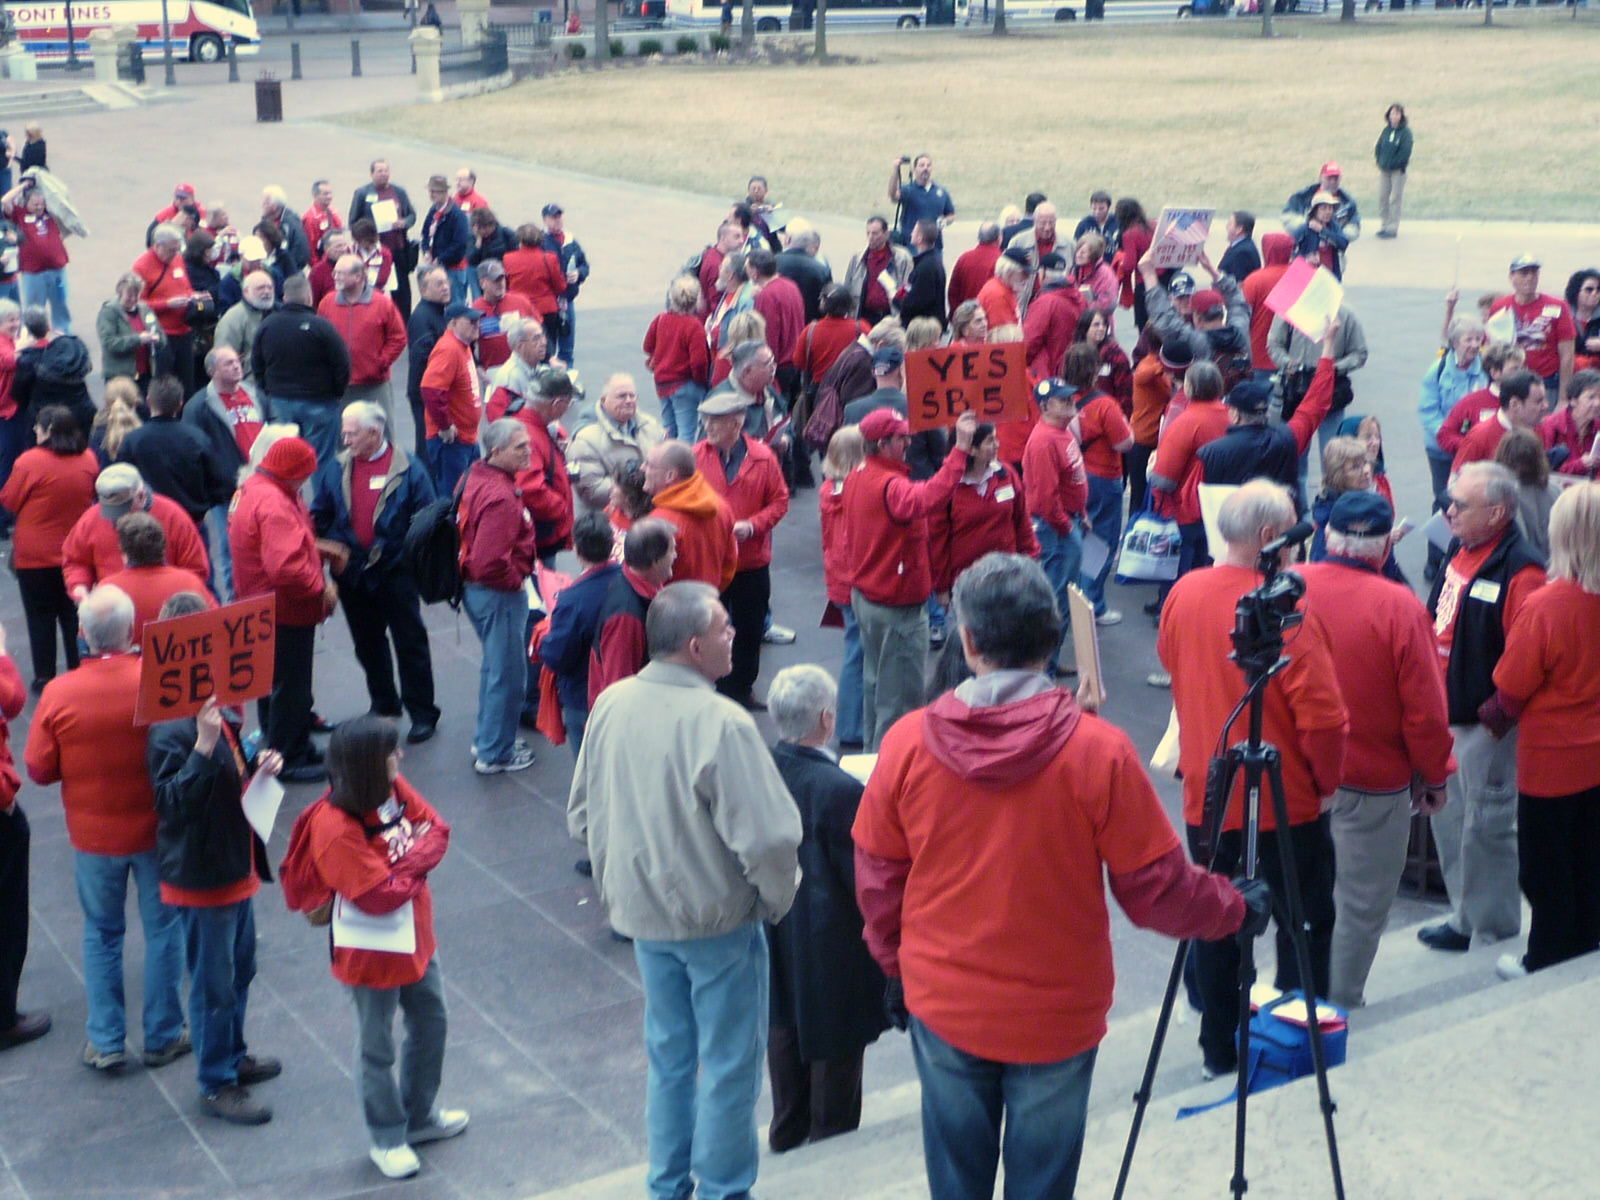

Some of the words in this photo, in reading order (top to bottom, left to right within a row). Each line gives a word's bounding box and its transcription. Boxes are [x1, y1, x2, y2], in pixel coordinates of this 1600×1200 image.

[928, 349, 1008, 381] YES
[983, 386, 1005, 415] 5
[223, 608, 273, 648] YES
[159, 662, 215, 707] SB
[228, 650, 255, 692] 5
